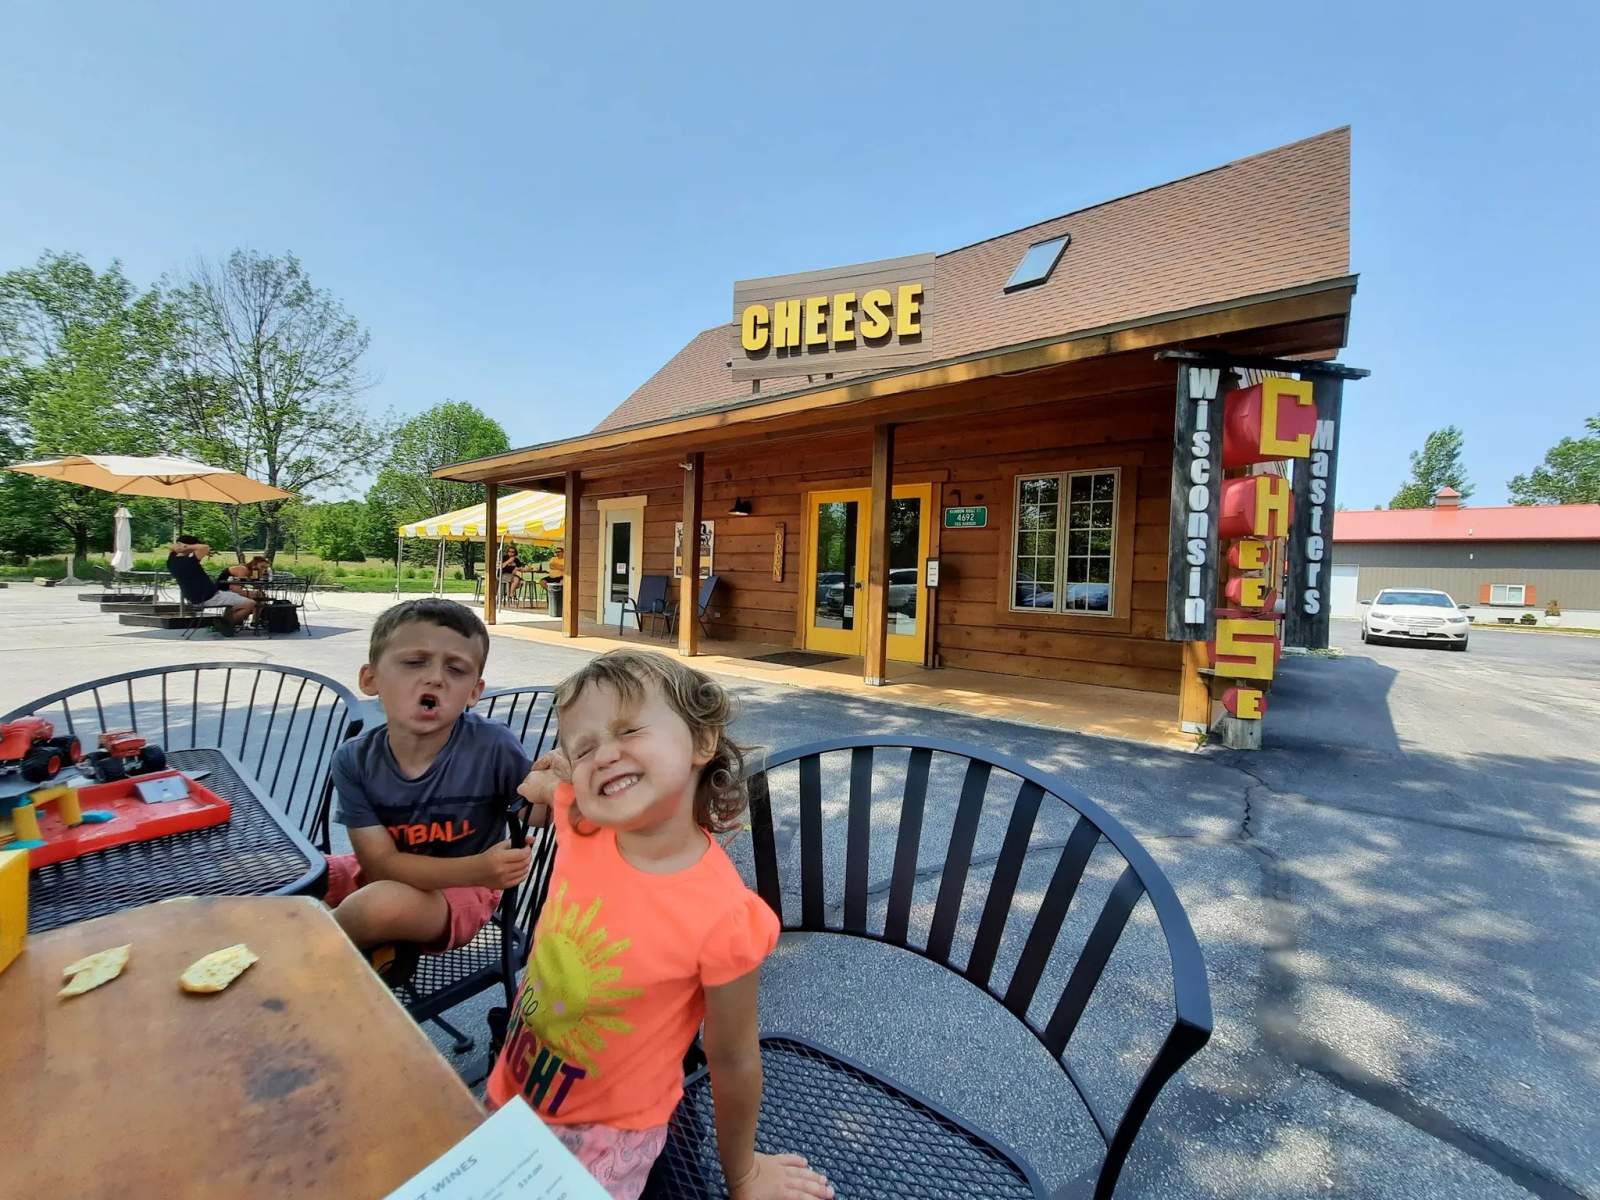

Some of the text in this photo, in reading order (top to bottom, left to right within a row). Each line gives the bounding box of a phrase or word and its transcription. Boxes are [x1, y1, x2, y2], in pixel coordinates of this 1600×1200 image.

[741, 283, 923, 351] CHEESE
[956, 513, 975, 522] 4692
[1216, 376, 1313, 720] CHEESE
[506, 1007, 587, 1116] IGHT
[432, 1155, 478, 1193] WINES
